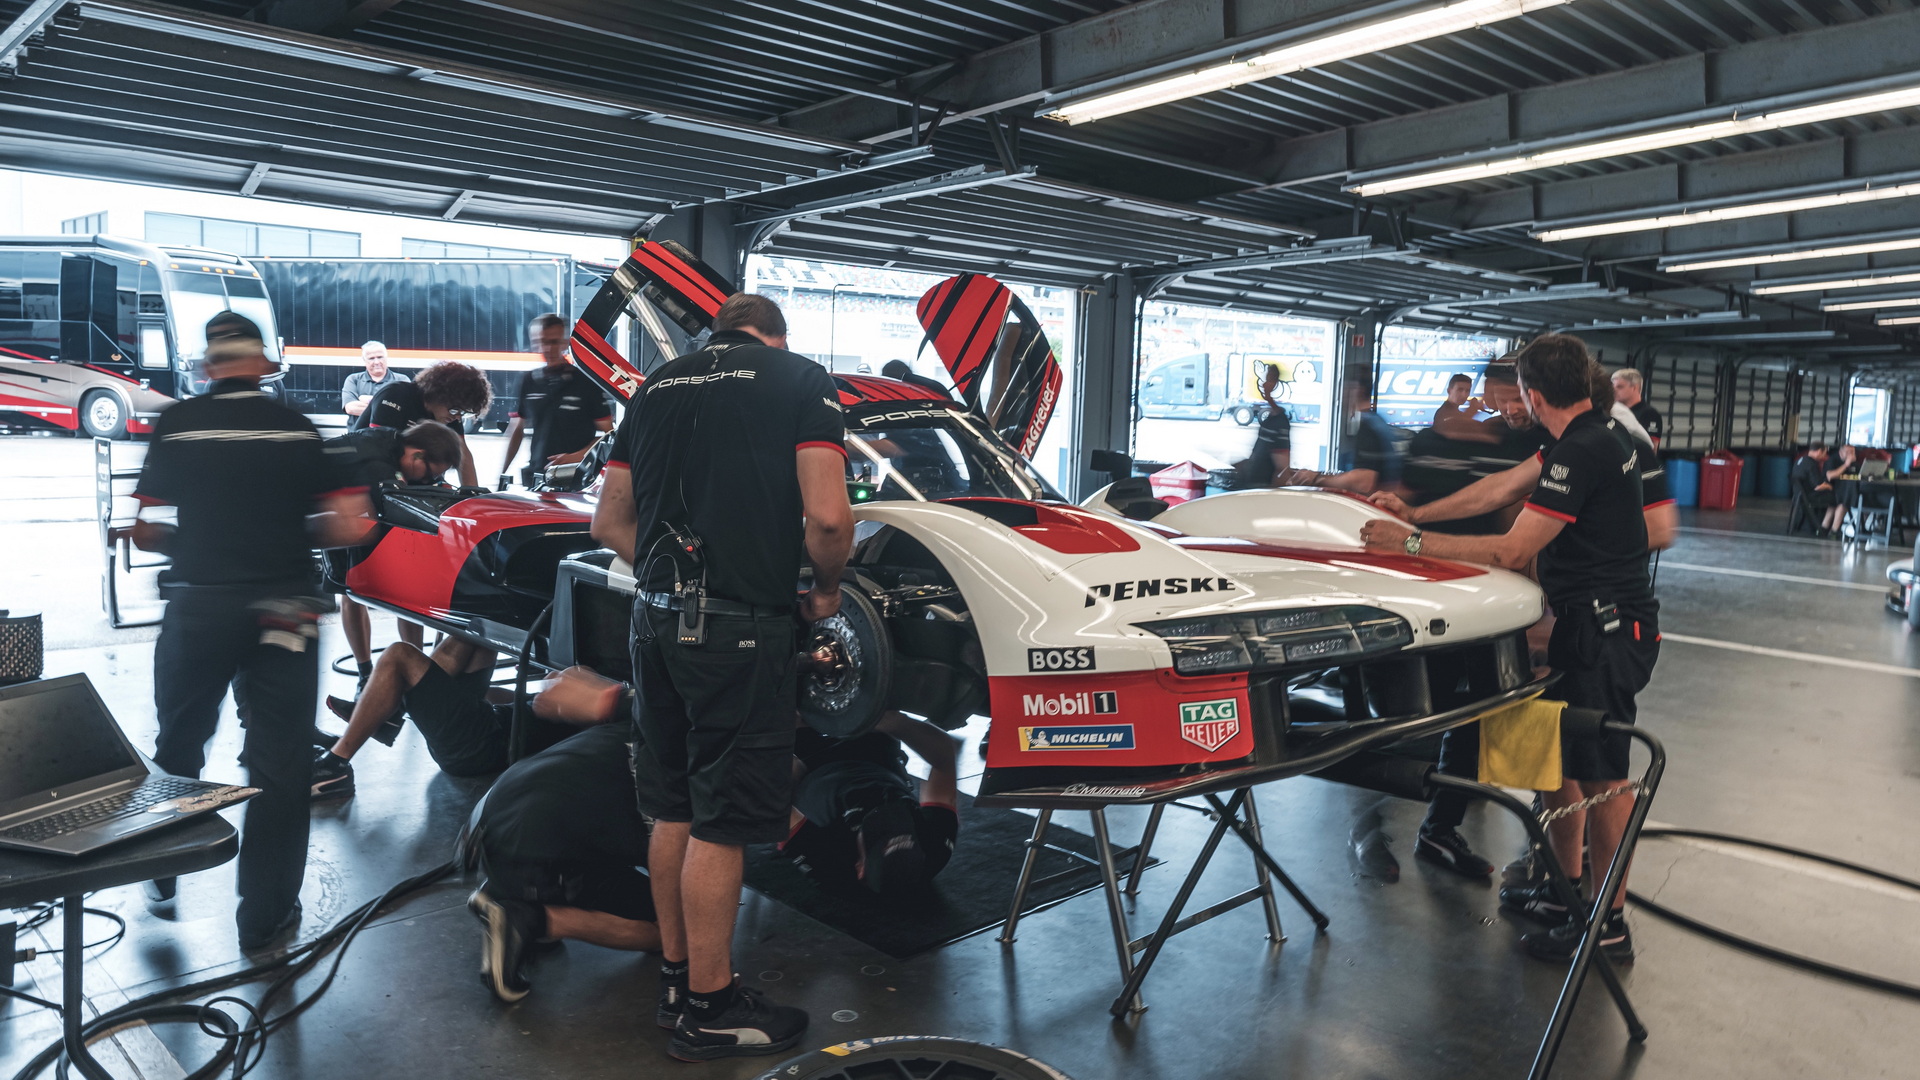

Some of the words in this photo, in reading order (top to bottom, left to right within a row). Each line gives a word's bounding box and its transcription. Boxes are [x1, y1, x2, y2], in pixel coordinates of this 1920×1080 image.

[646, 370, 756, 395] PORSCHE
[860, 410, 950, 427] PORS
[1085, 578, 1235, 608] PENSKE
[1032, 650, 1090, 669] BOSS
[1023, 692, 1090, 716] Mobil
[1185, 703, 1232, 721] TAG
[1051, 732, 1124, 744] MICHELIN
[1185, 721, 1235, 747] HEUER
